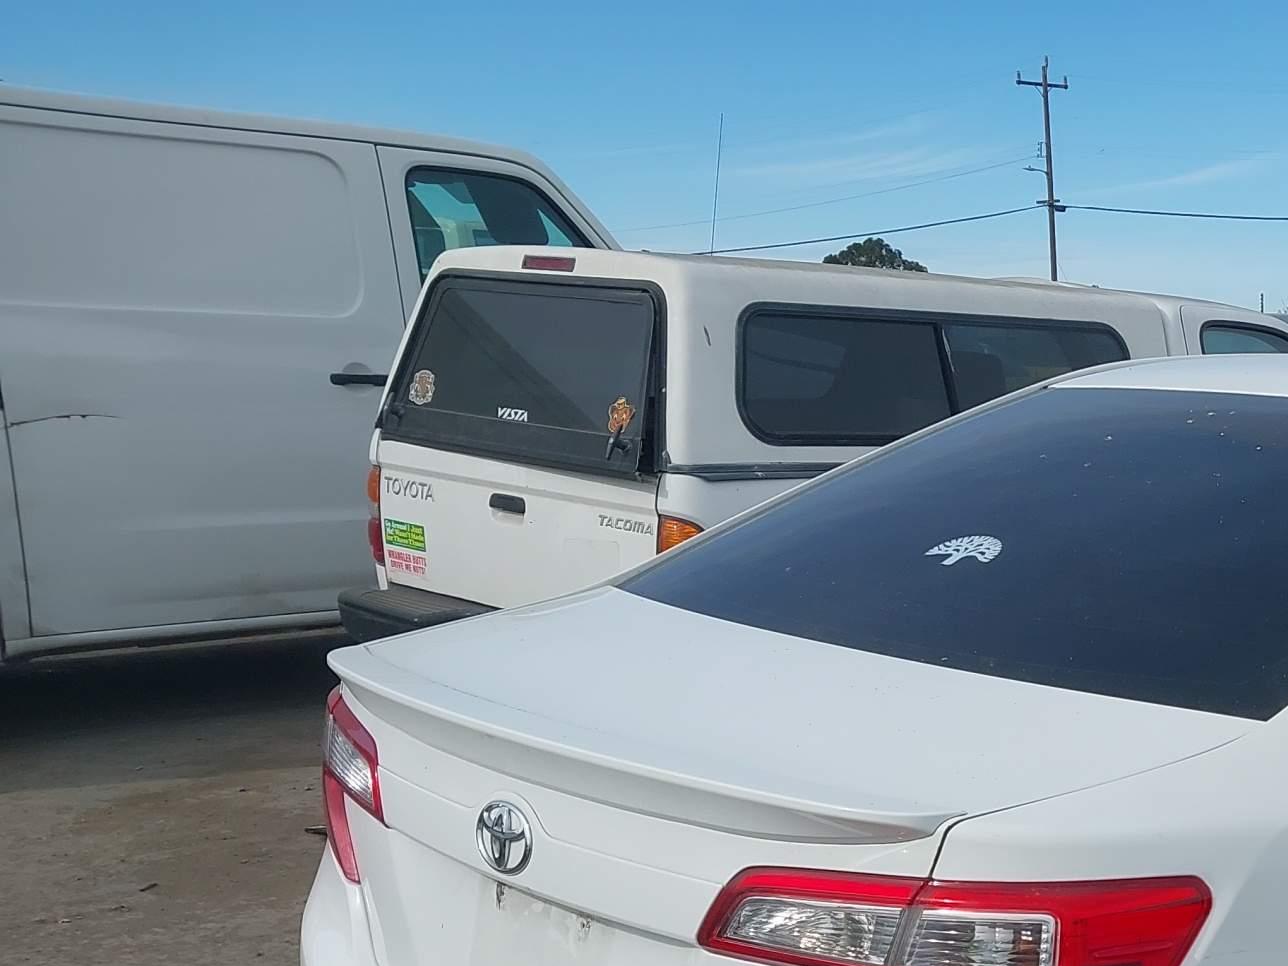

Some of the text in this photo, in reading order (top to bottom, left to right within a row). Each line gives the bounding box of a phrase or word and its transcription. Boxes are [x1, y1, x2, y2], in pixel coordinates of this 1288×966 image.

[497, 406, 528, 422] VISTA
[384, 476, 434, 502] TOYOTA
[598, 514, 653, 535] TACOMA
[388, 549, 411, 563] WRANGLER
[391, 559, 404, 570] DRIVE
